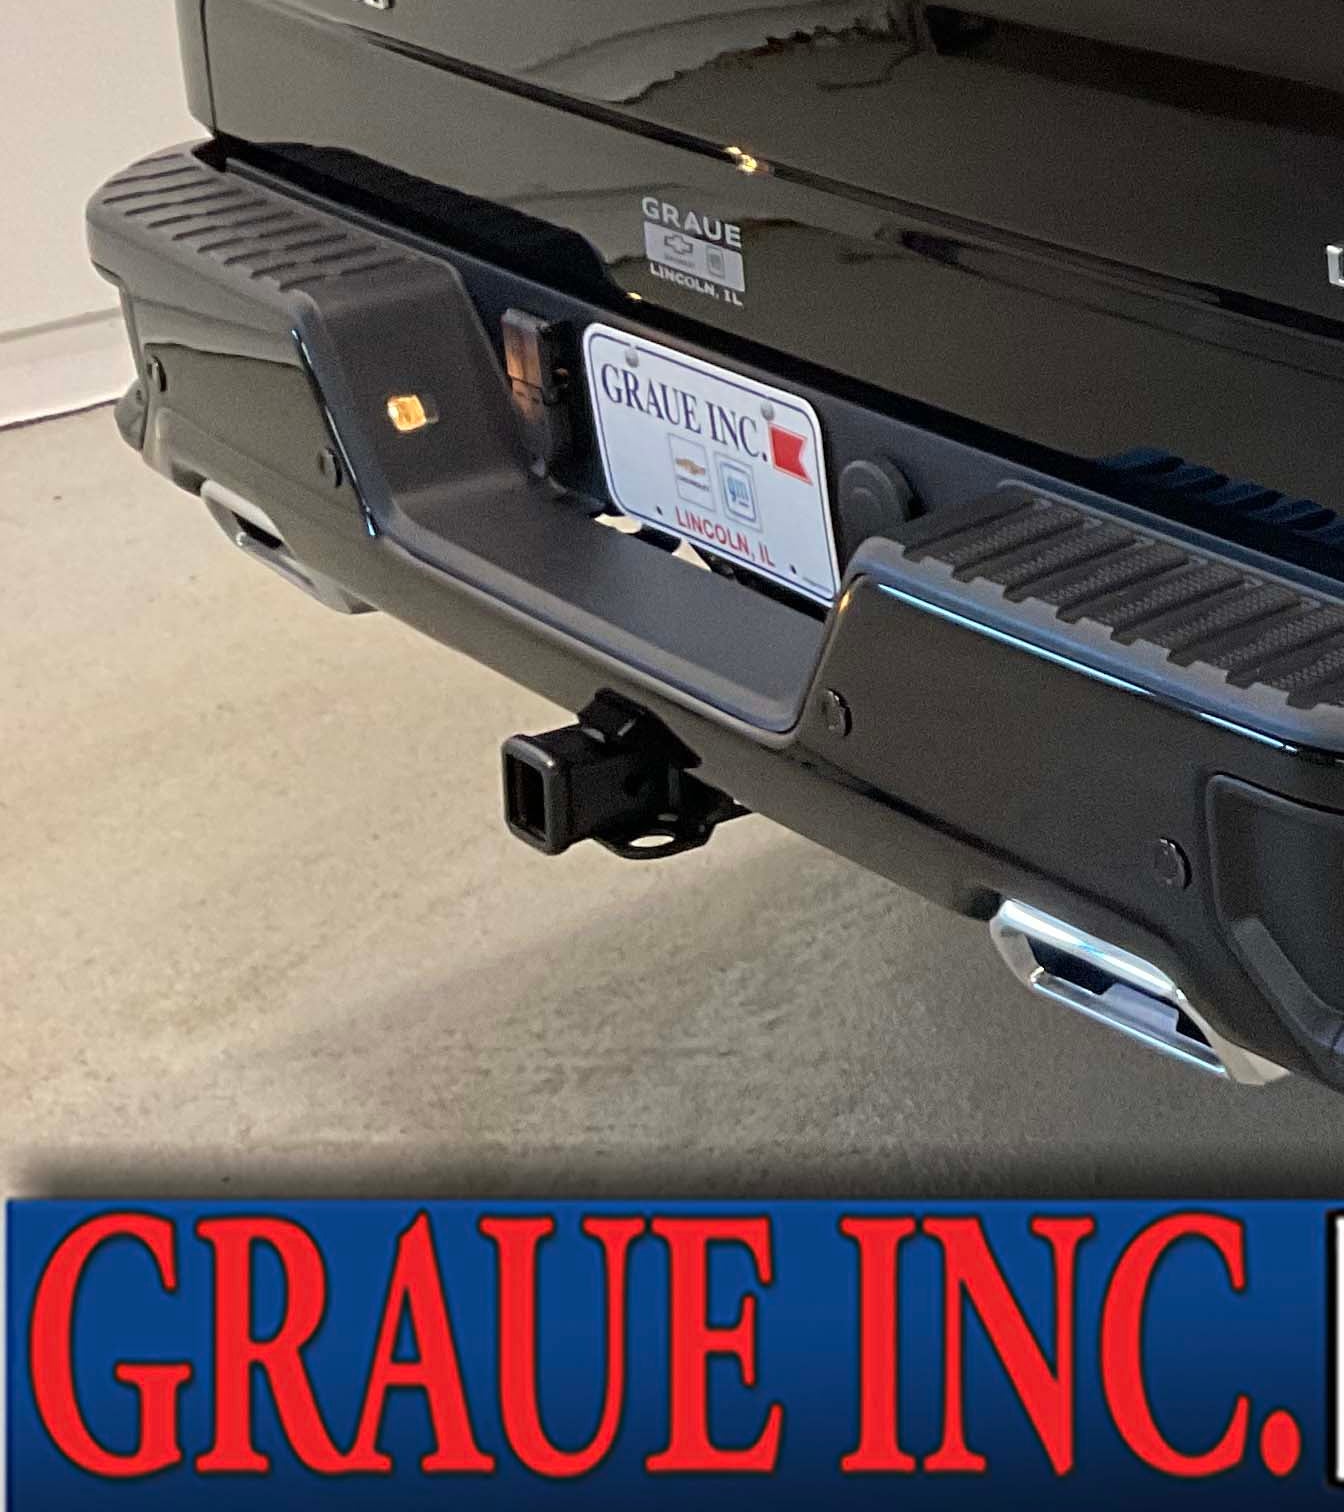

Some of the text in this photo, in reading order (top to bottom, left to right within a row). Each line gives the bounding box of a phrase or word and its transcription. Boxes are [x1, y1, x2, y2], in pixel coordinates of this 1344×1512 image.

[641, 195, 743, 249] GRAUE
[649, 261, 744, 307] LINCOLN, IL
[601, 363, 769, 463] GRAUE INC.
[674, 504, 776, 568] LINCOLN, IL
